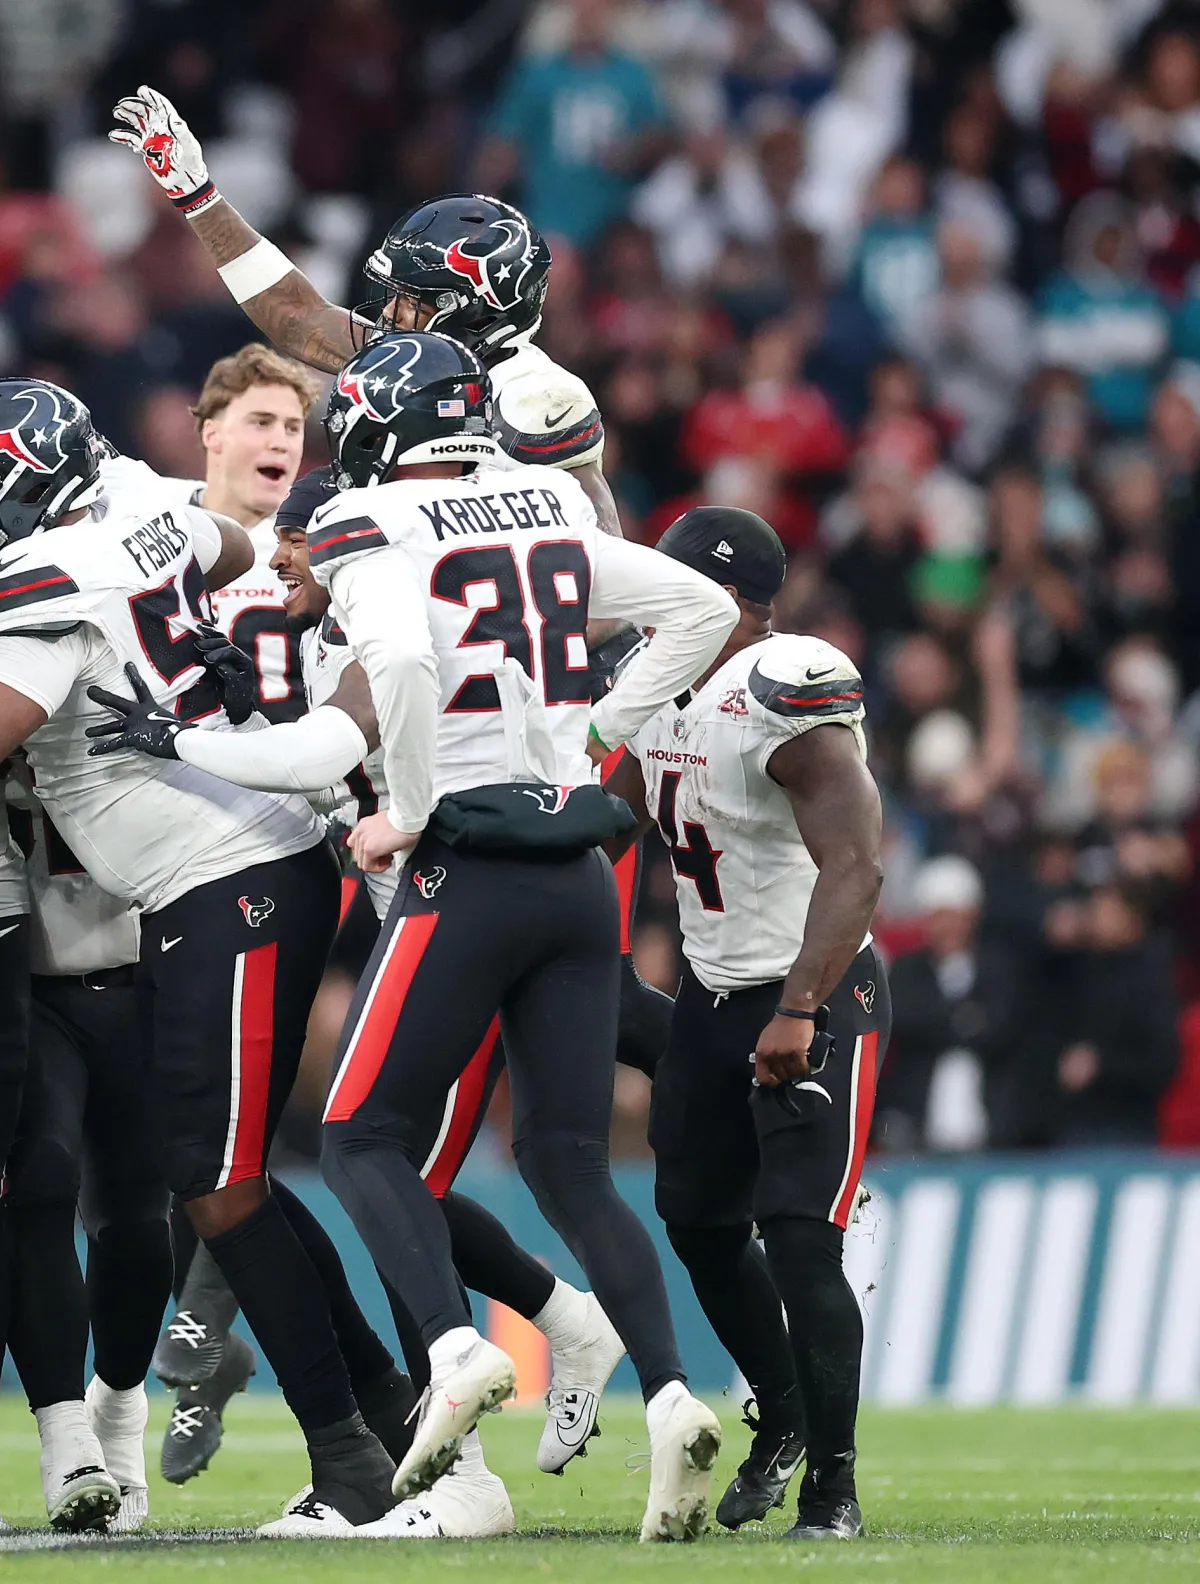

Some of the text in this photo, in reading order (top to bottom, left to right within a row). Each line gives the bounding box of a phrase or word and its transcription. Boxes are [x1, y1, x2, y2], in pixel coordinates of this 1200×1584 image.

[430, 444, 496, 456] HOUSTON
[418, 488, 569, 542] KROEGER
[121, 511, 189, 579] FISHER
[212, 588, 275, 598] STON
[430, 539, 591, 714] 38
[646, 749, 707, 767] HOUSTON
[657, 769, 725, 913] 4
